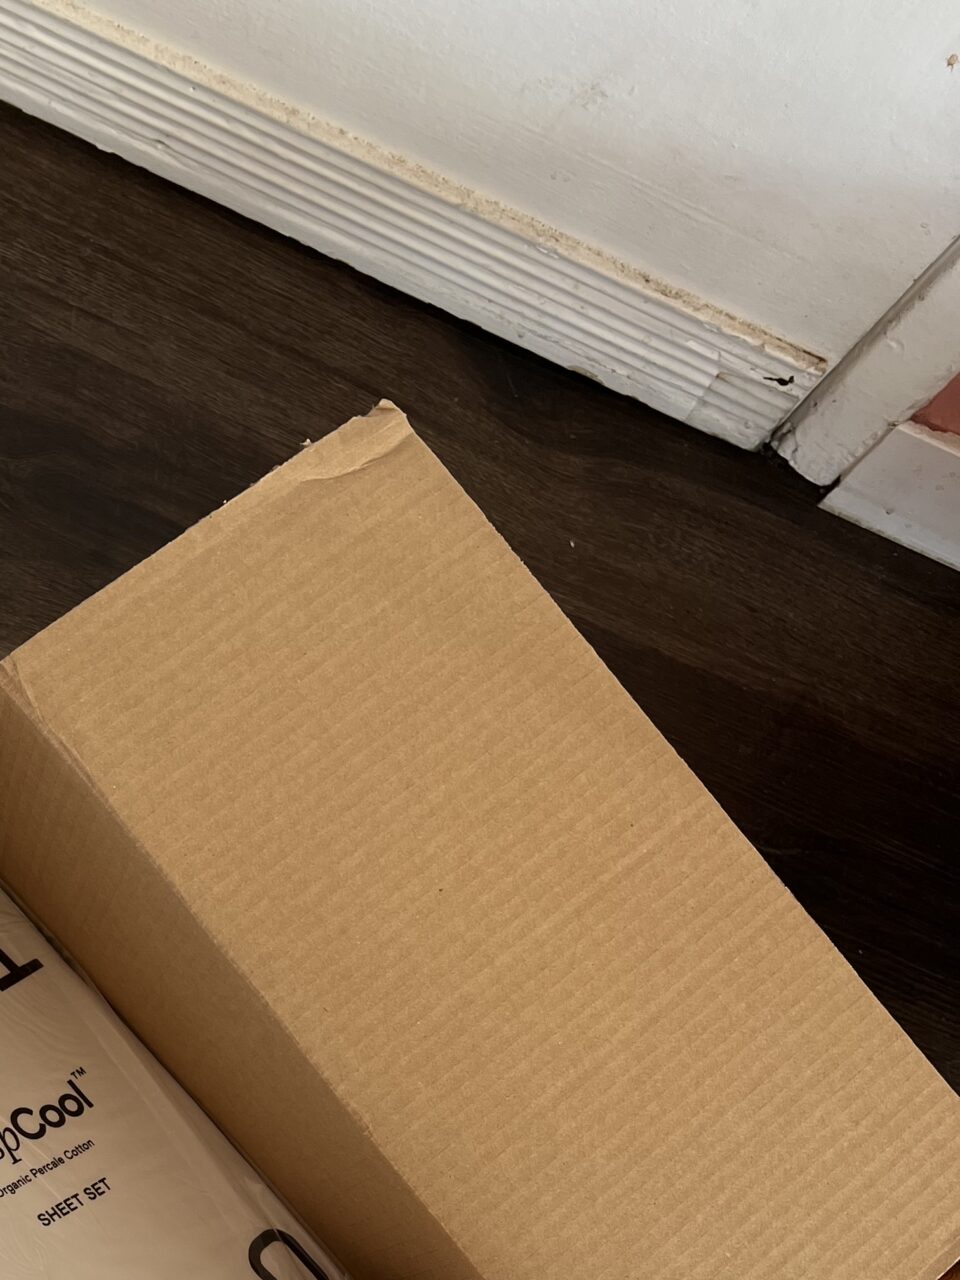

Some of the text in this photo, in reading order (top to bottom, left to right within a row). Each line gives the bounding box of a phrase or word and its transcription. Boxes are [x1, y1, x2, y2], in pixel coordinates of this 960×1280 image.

[30, 1157, 65, 1178] Percale
[64, 1139, 95, 1160] Cotton
[37, 1177, 112, 1227] SHEET SET
